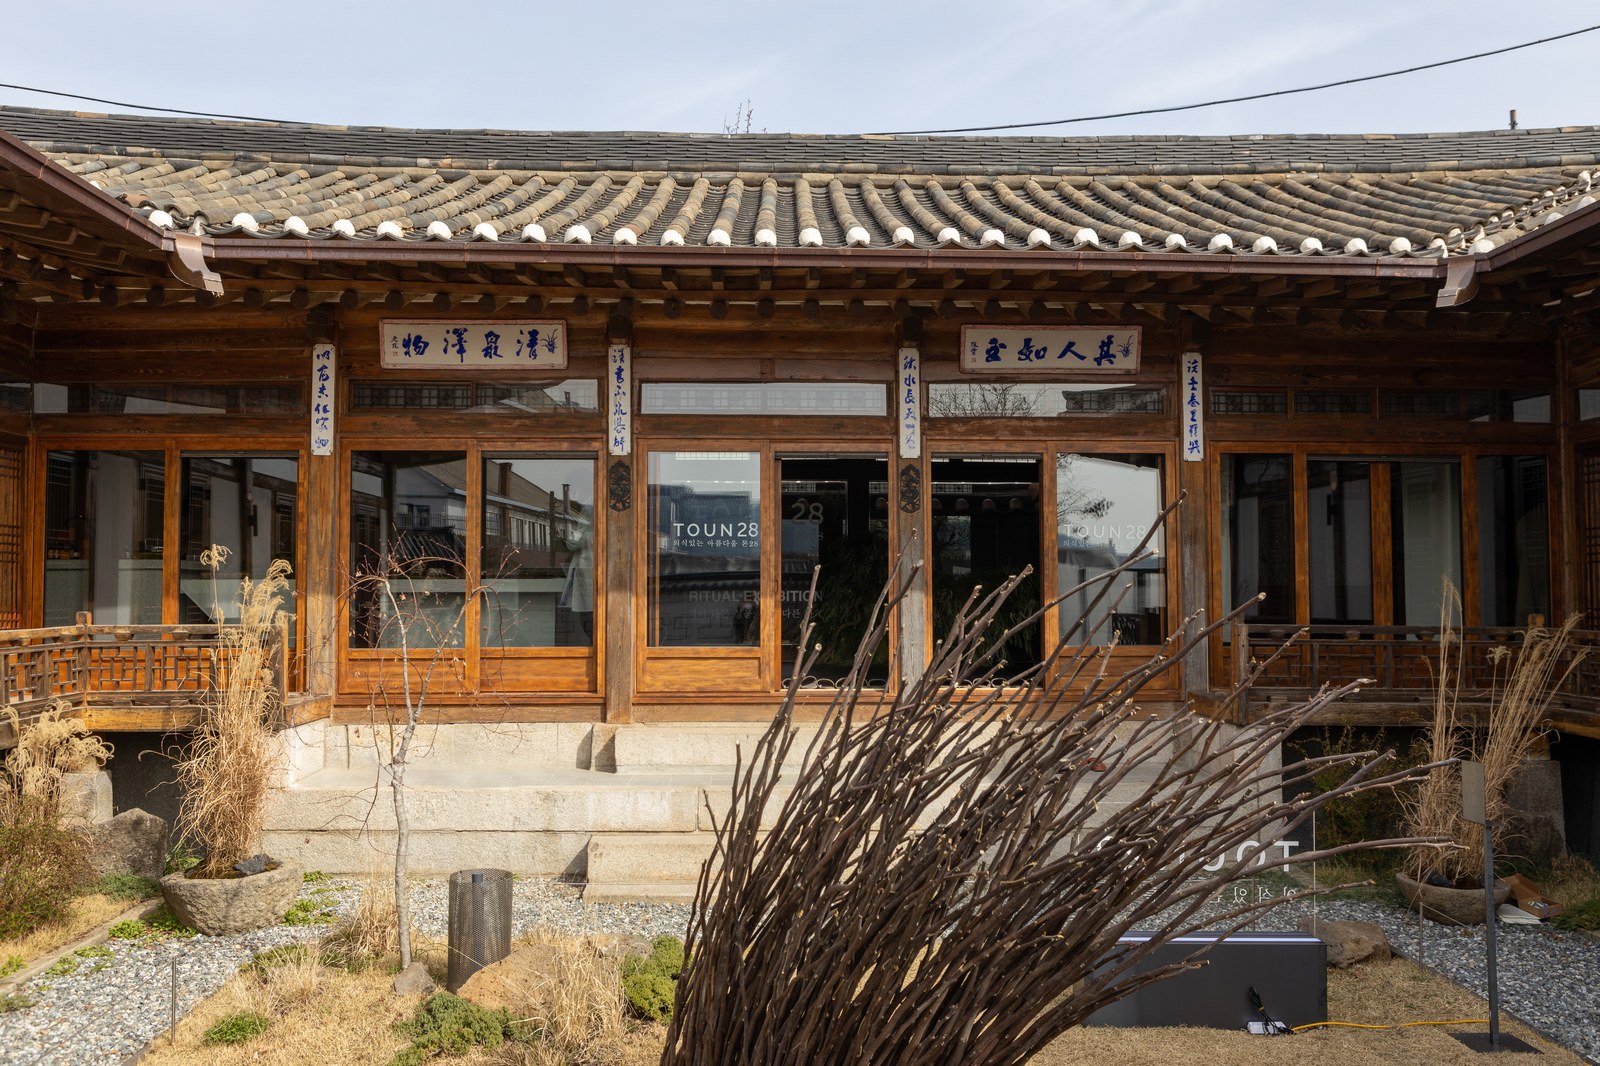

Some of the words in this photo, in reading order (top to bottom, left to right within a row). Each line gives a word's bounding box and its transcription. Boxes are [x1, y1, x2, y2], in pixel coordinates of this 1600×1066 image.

[673, 522, 758, 537] TOUN28
[1063, 523, 1146, 540] TOUN28
[673, 539, 704, 547] 의식있는
[707, 539, 738, 547] 아름다움
[689, 590, 740, 602] RITUAL
